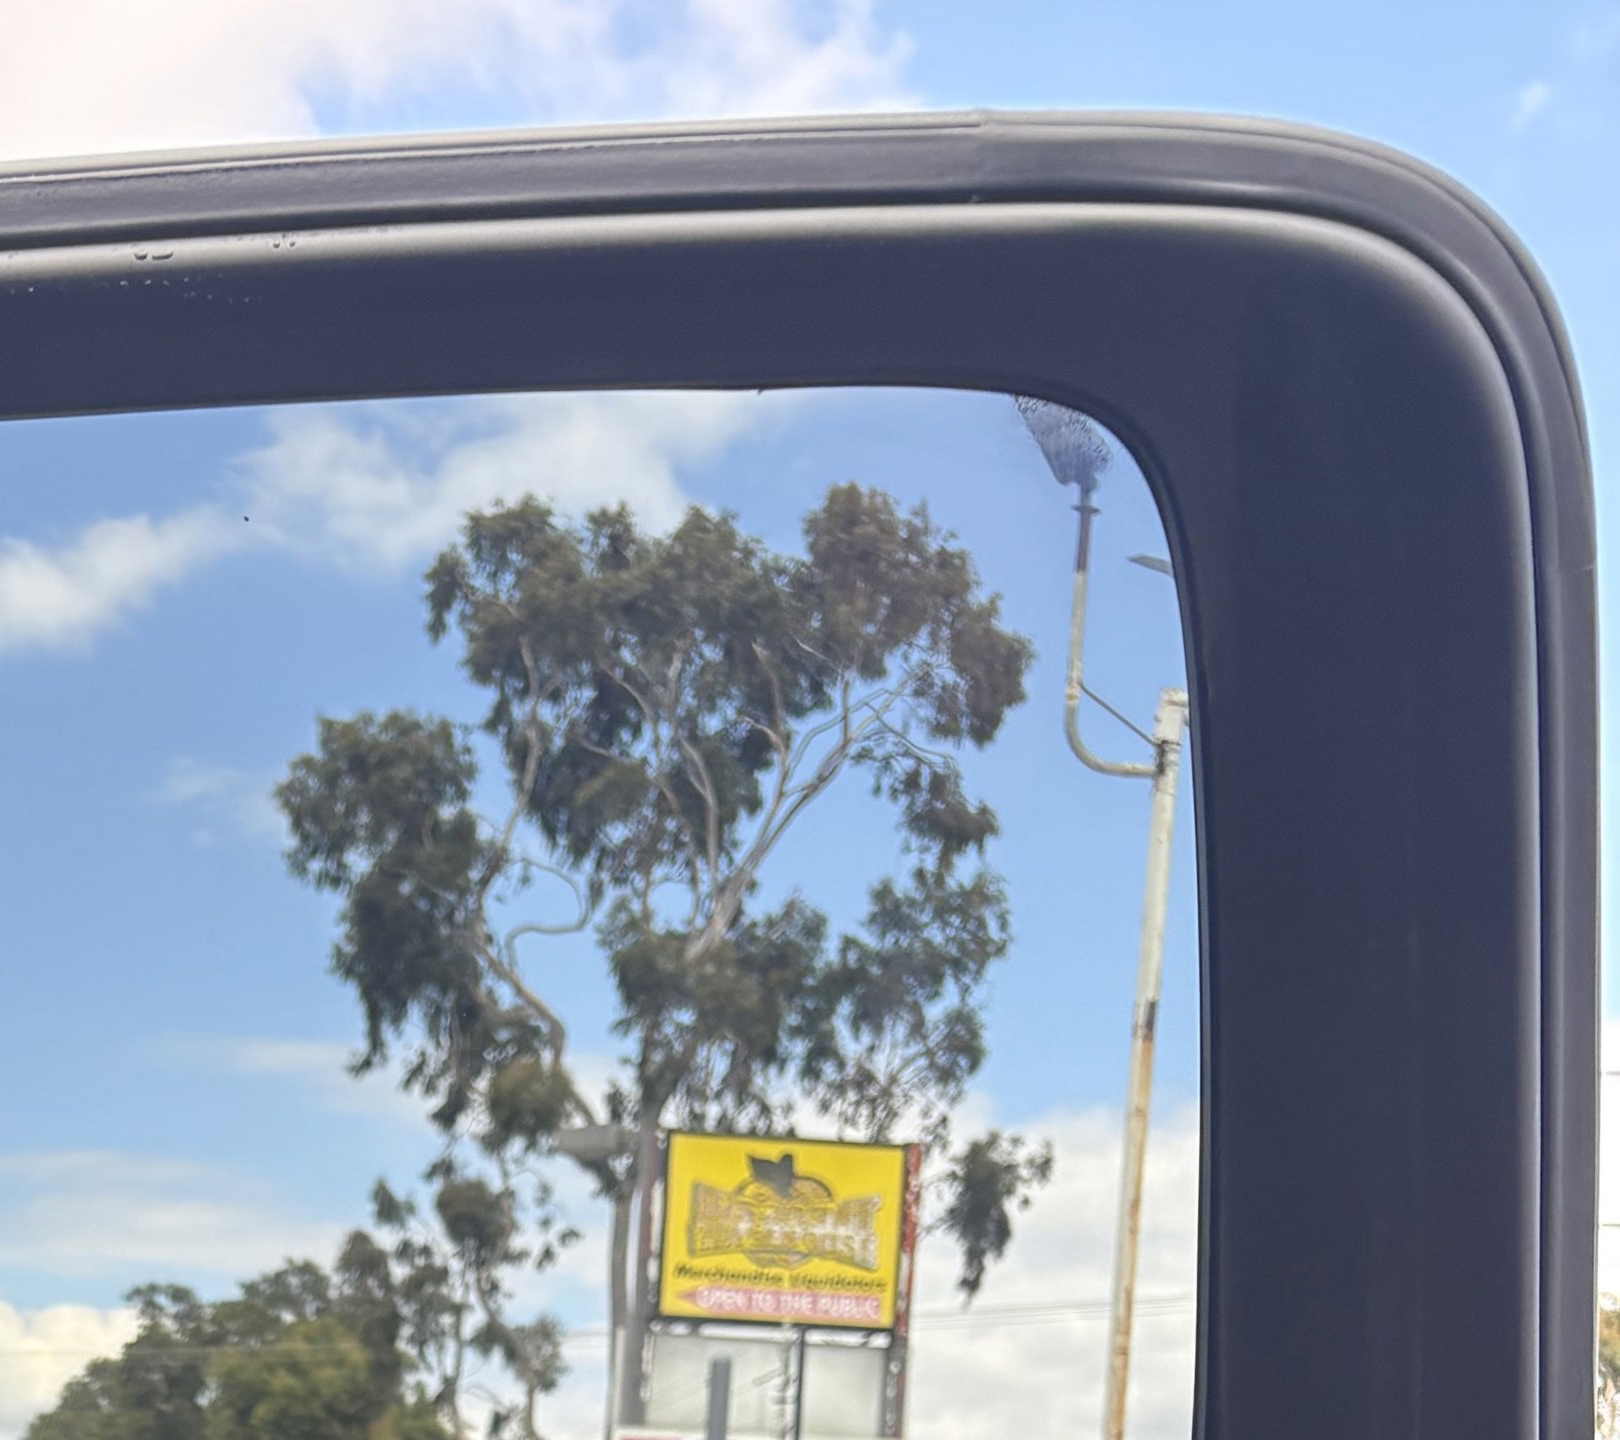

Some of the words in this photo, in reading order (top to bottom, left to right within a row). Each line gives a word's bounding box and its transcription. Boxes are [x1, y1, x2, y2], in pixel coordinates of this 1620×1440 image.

[751, 1288, 777, 1311] TO
[779, 1291, 813, 1315] THE
[816, 1294, 880, 1319] PUBLIC
